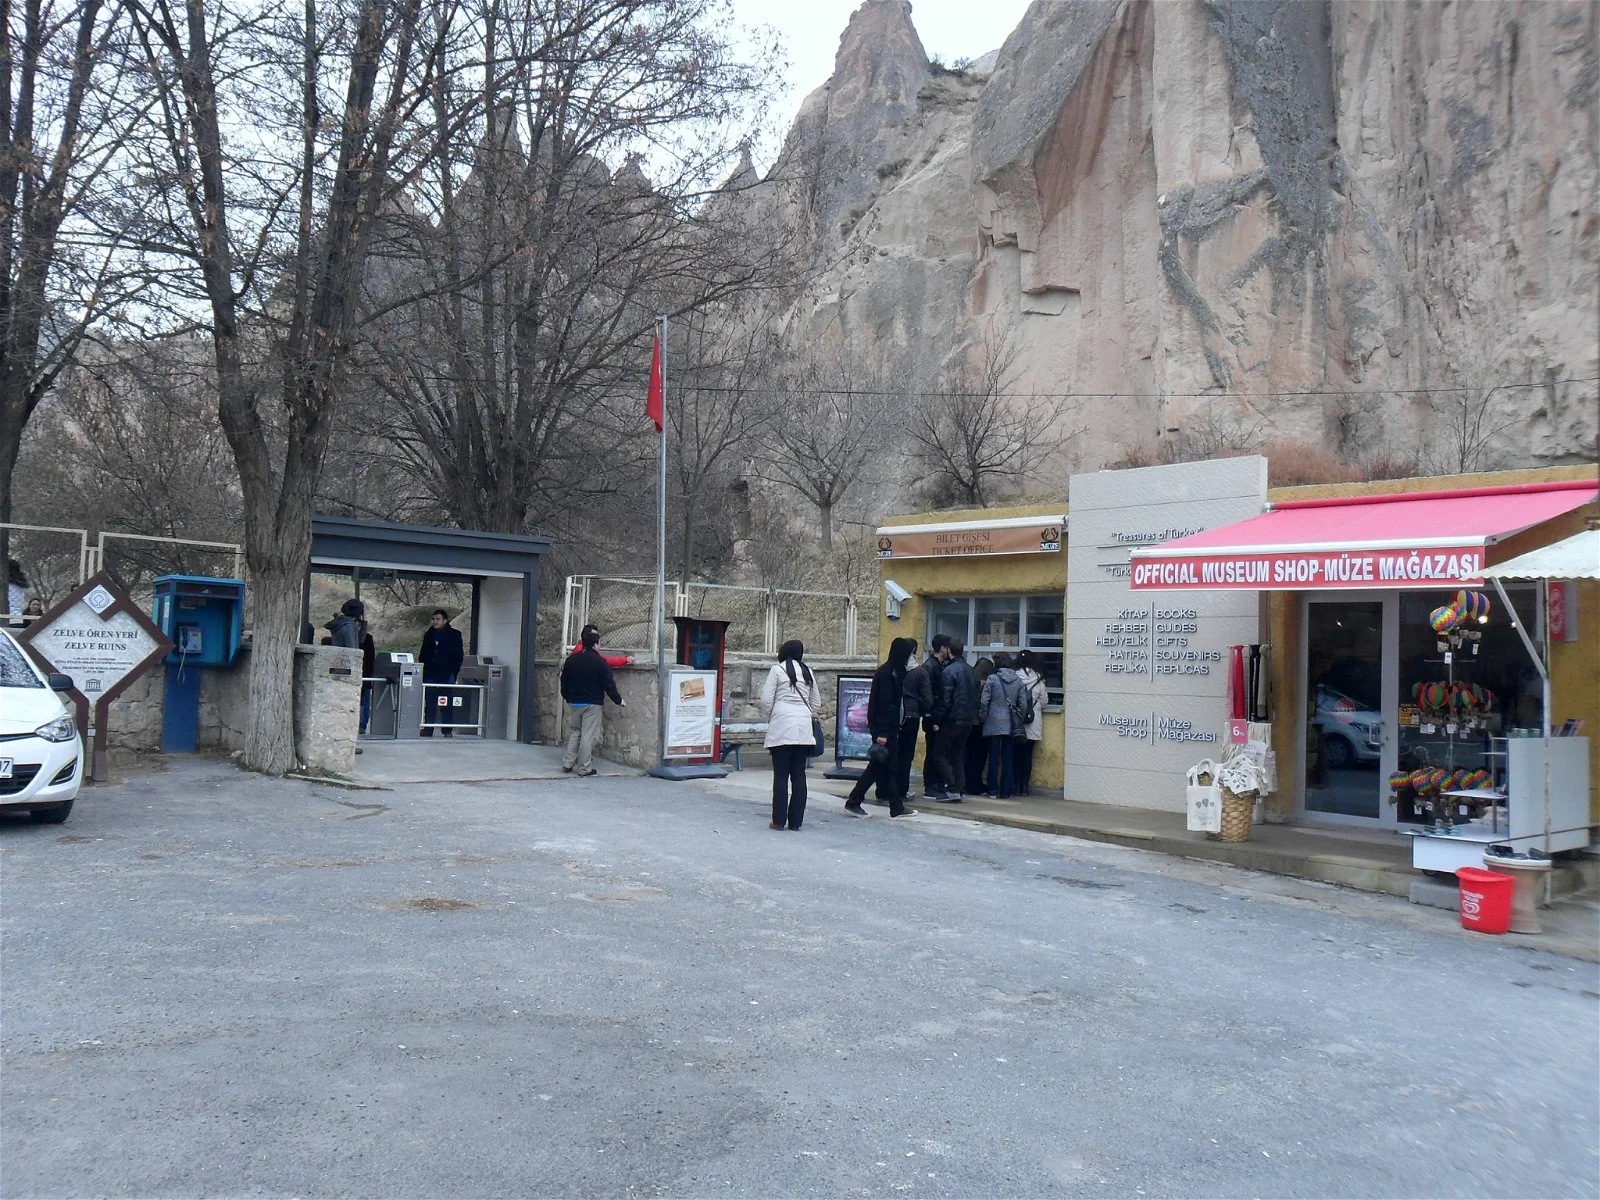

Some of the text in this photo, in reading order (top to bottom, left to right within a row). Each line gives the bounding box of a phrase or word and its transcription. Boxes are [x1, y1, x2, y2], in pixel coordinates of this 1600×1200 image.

[1159, 529, 1168, 540] of
[932, 545, 995, 556] TICKET OFFICE
[1134, 562, 1199, 585] OFFICIAL
[1202, 560, 1270, 583] MUSEUM
[1379, 550, 1479, 580] MAĞAZASI
[1117, 609, 1148, 619] KİTAP
[1156, 609, 1197, 619] BOOKS
[53, 628, 138, 639] ZELVE ÖREN YERİ
[1105, 624, 1148, 633] REHBER
[1155, 624, 1198, 633] GUIDES
[1095, 635, 1148, 646] HEDİYELİK
[1155, 637, 1188, 646] GIFTS
[64, 642, 127, 651] ZELVE RUINS
[1109, 650, 1148, 660] HATIRA
[1155, 651, 1221, 660] SOUVENIRS
[1105, 662, 1148, 673] REPLİKA
[1155, 664, 1210, 675] REPLICAS
[1098, 714, 1148, 727] Museum
[1159, 717, 1191, 729] Müze
[1117, 726, 1148, 739] Shop
